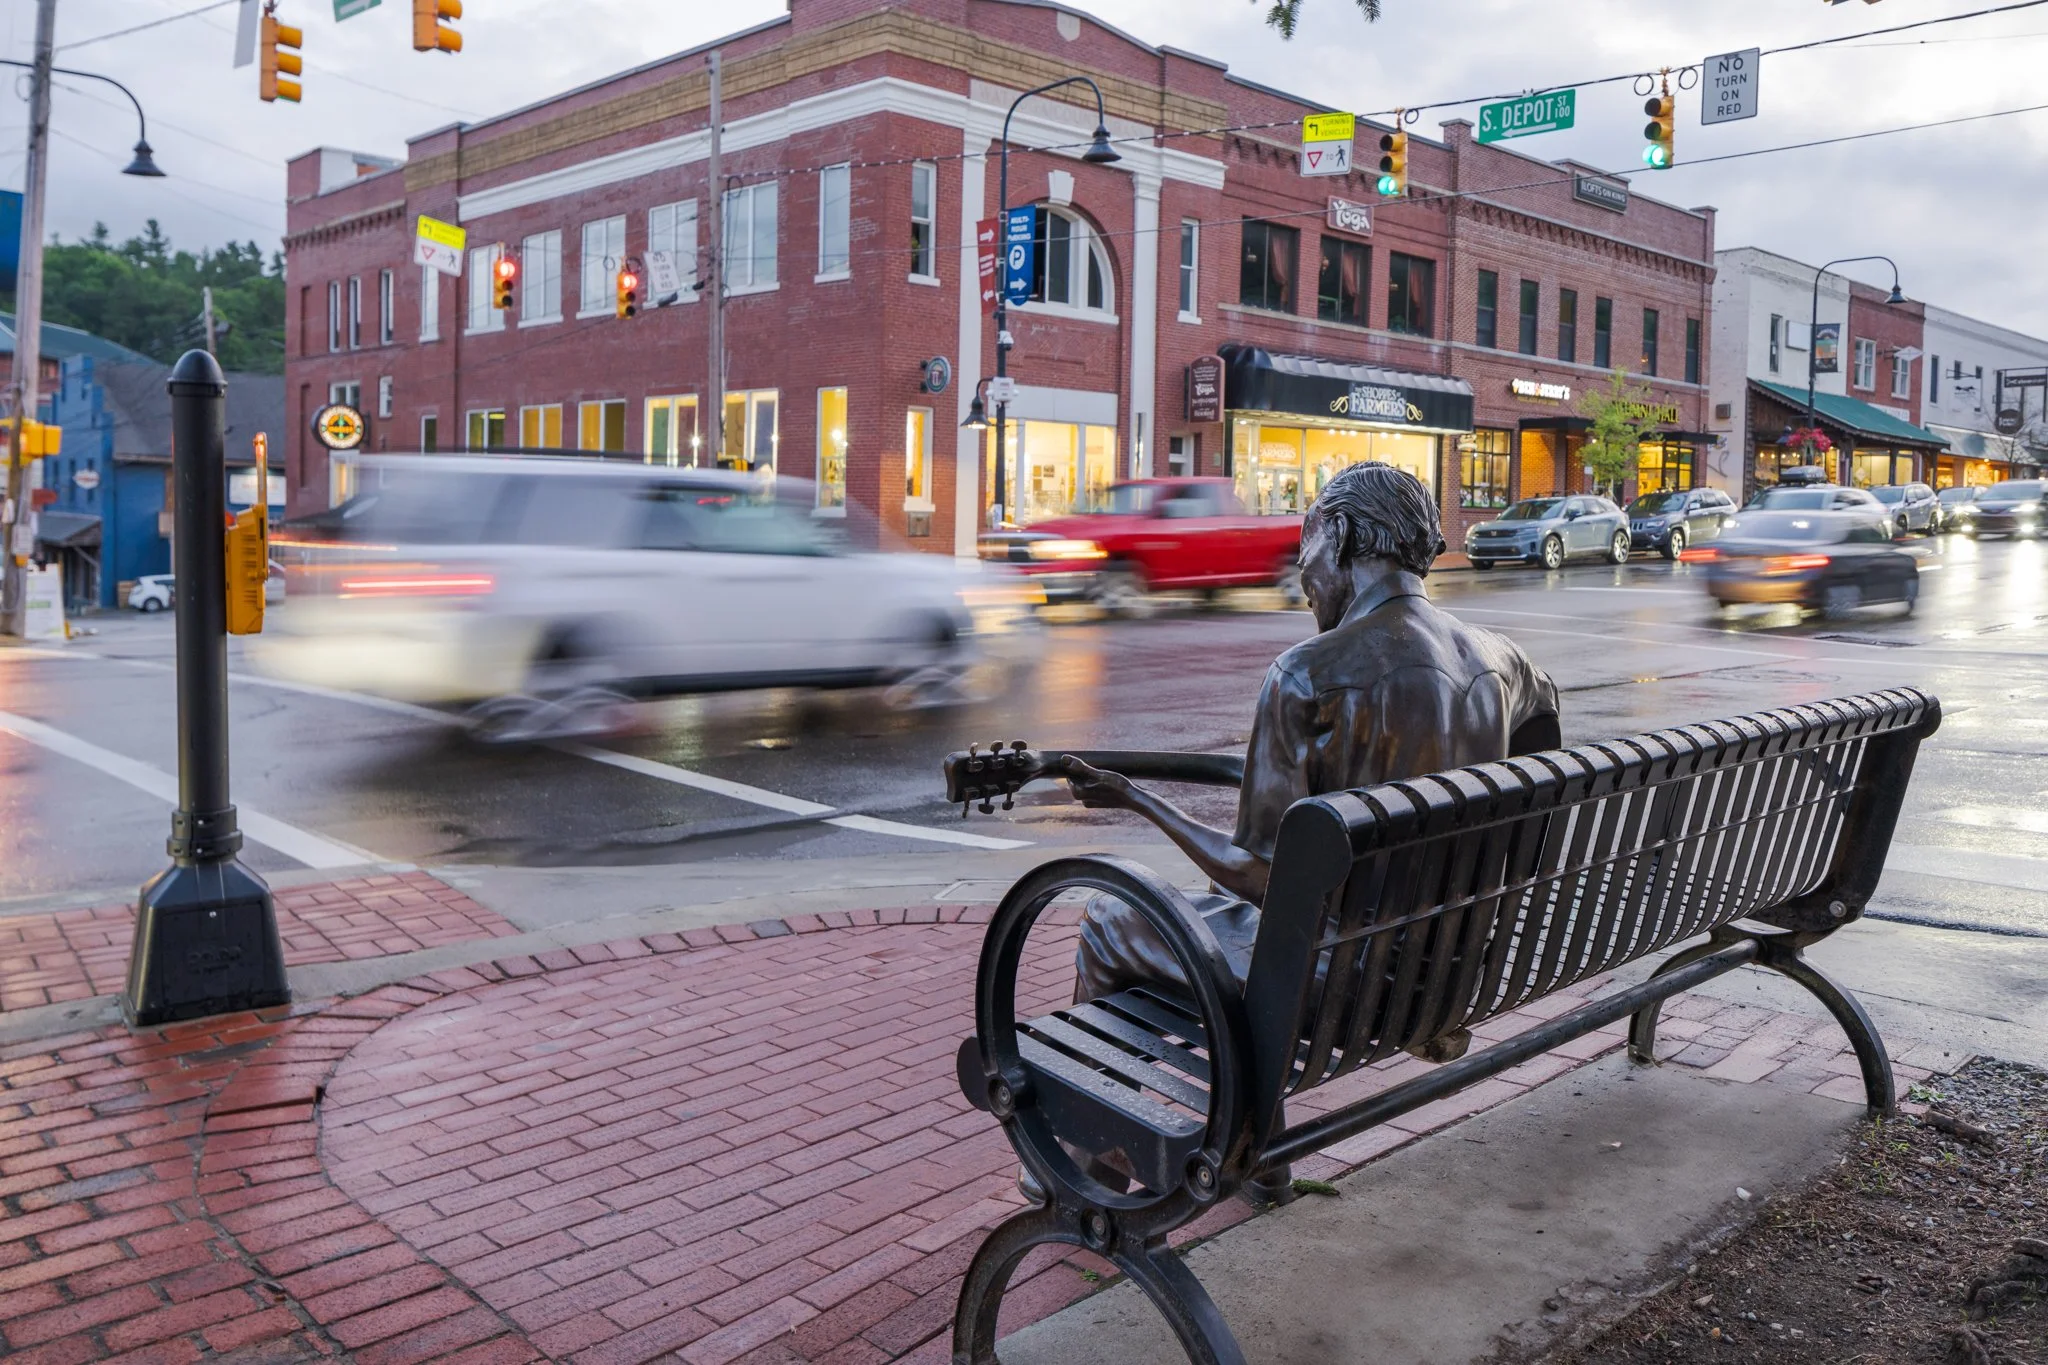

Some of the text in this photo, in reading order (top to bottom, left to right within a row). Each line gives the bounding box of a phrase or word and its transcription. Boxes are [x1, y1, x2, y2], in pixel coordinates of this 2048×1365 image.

[1718, 57, 1744, 74] NO
[1715, 73, 1747, 89] TURN
[1557, 95, 1567, 107] ST
[1721, 88, 1739, 101] ON
[1482, 98, 1554, 132] S. DEPOT
[1555, 105, 1570, 118] 100
[1717, 102, 1742, 116] RED
[1323, 117, 1350, 126] TURNING
[1321, 127, 1350, 137] VEHICLES
[1326, 152, 1335, 161] TO
[1582, 180, 1626, 203] LOFTS ON KING
[1332, 199, 1370, 231] Yoga
[1013, 249, 1021, 266] P
[1361, 386, 1397, 401] SHOPPES
[1349, 392, 1406, 417] FARMERS
